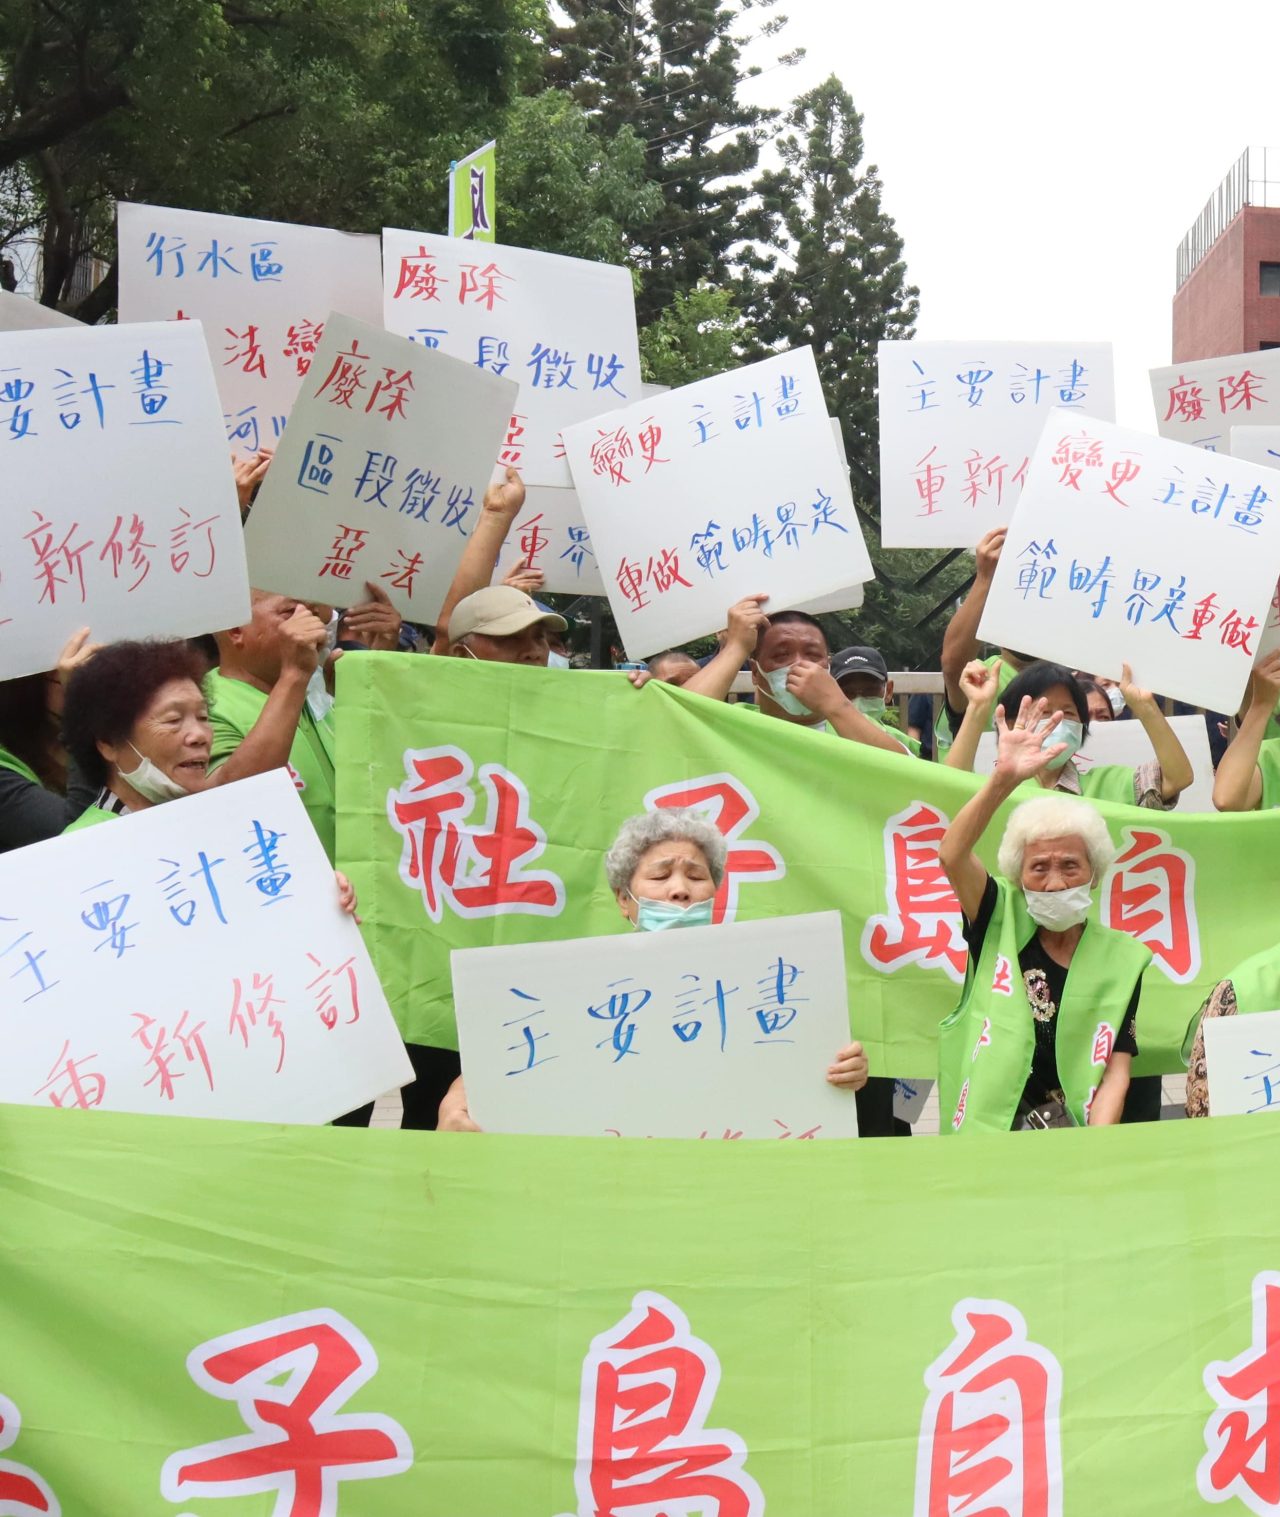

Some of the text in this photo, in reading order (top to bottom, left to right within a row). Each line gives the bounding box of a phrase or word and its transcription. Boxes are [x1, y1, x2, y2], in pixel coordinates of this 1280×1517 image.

[146, 232, 283, 282] 行水區
[393, 245, 516, 311] 廢除
[313, 339, 416, 421] 廢除
[905, 358, 1090, 412] 主要計畫
[1163, 369, 1269, 423] 廢除
[497, 413, 567, 470] 惡
[297, 433, 475, 537] 區段徵收
[0, 506, 221, 625] 新修訂
[318, 524, 425, 600] 惡法
[0, 819, 294, 1003] 主要計畫
[502, 956, 811, 1076] 主要計畫
